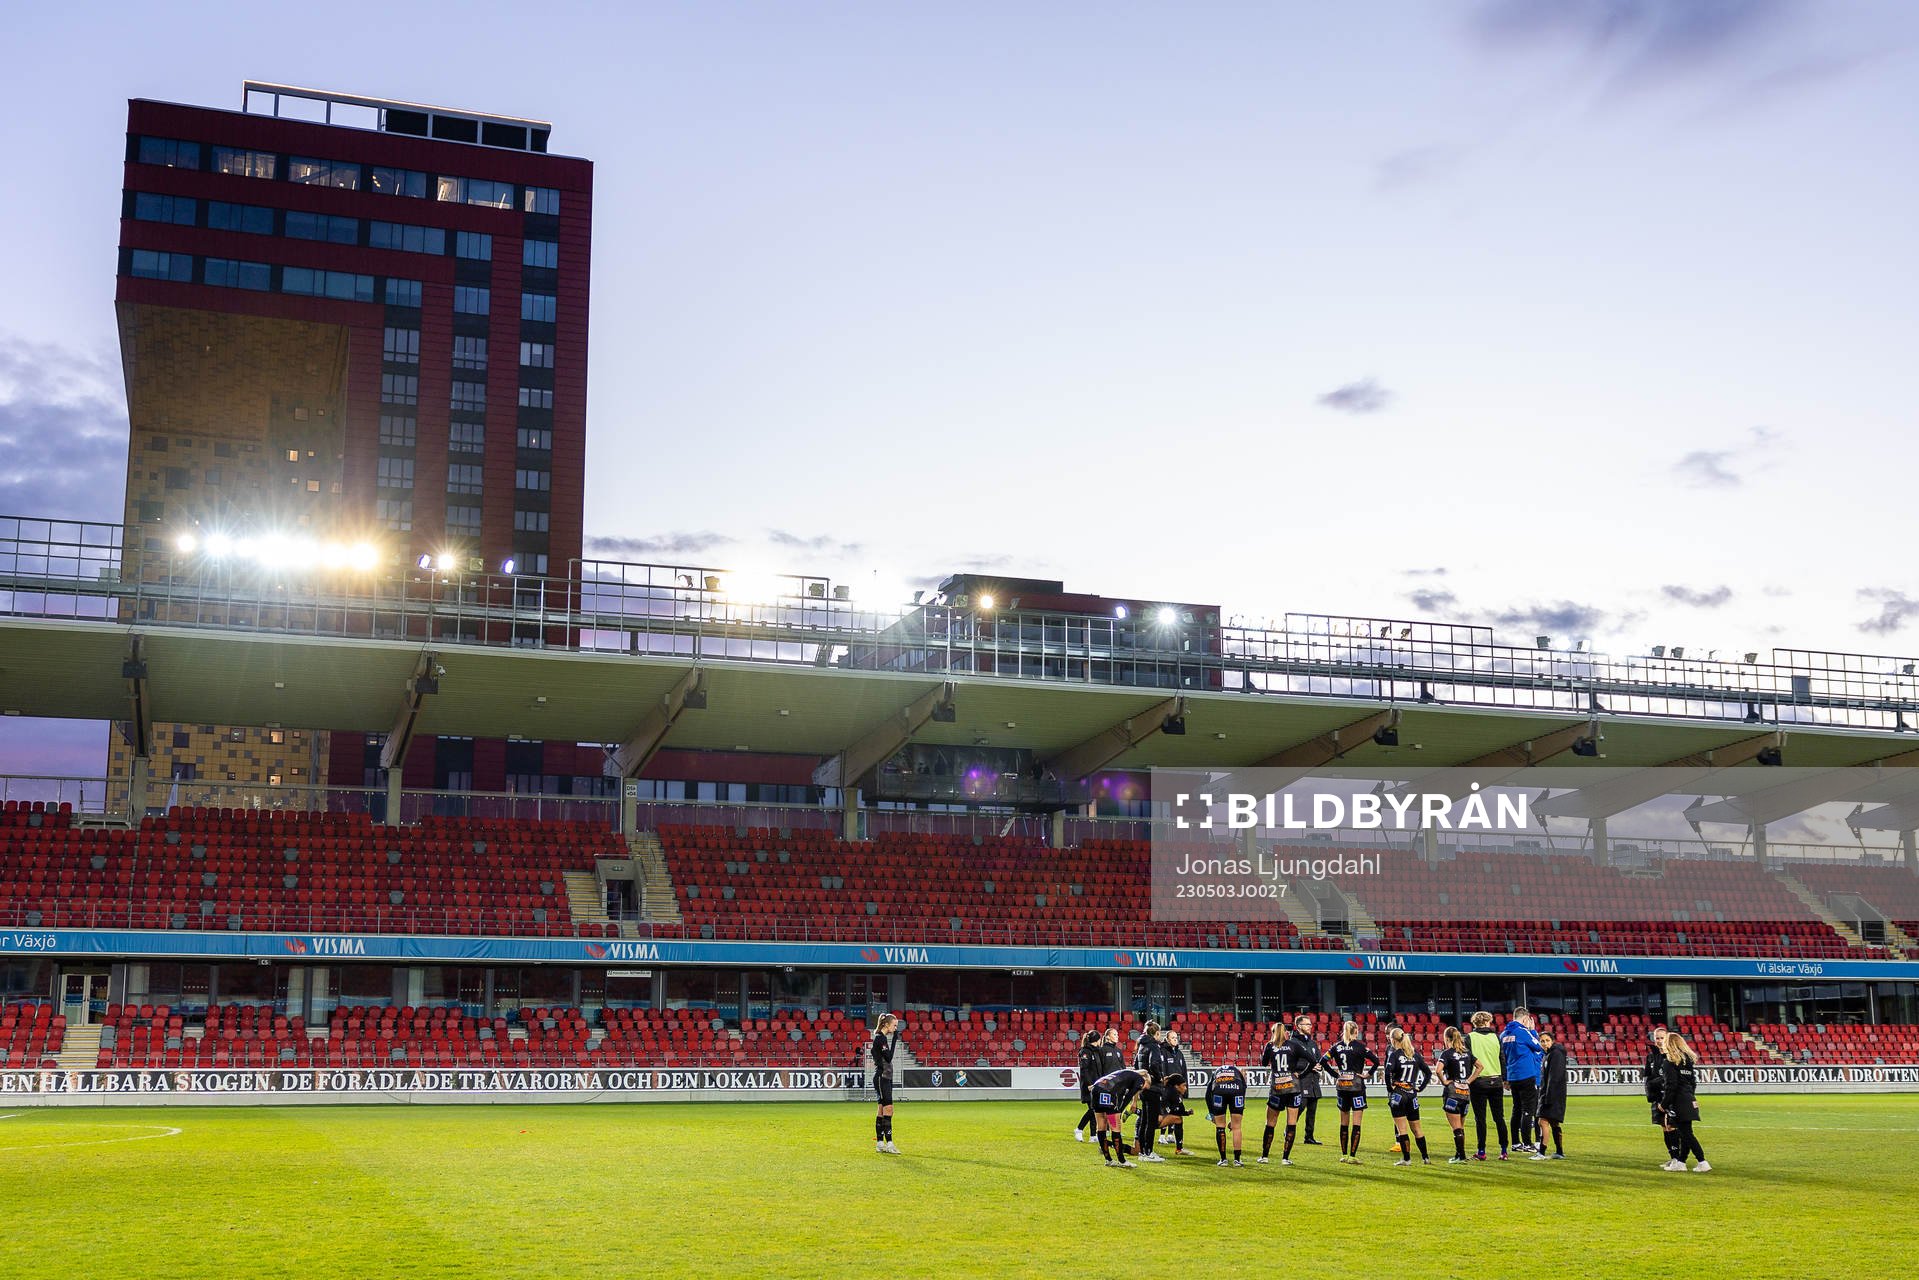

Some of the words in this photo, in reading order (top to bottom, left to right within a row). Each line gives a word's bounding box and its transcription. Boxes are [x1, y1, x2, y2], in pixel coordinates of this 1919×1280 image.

[0, 936, 9, 947] r
[14, 934, 56, 951] Växjö
[312, 938, 366, 954] VISMA
[610, 943, 660, 959] VISMA
[883, 947, 929, 963] VISMA
[1135, 951, 1178, 967] VISMA
[1367, 955, 1407, 970] VISMA
[1582, 959, 1619, 973] VISMA
[1756, 963, 1766, 973] Vi
[1768, 963, 1796, 974] älskar
[1797, 964, 1823, 976] Växjö
[1275, 1053, 1289, 1072] 14
[1339, 1053, 1348, 1071] 3
[1459, 1060, 1467, 1079] 5
[176, 1073, 276, 1092] SKOGEN,
[282, 1073, 312, 1091] DE
[318, 1070, 453, 1091] FÖRÄDLADE
[458, 1070, 604, 1090] TRÄVARORNA
[607, 1072, 652, 1090] OCH
[656, 1072, 700, 1090] DEN
[703, 1072, 784, 1090] LOKALA
[1400, 1064, 1414, 1082] 77
[1567, 1069, 1618, 1084] DLADE
[1724, 1068, 1755, 1083] OCH
[1757, 1068, 1787, 1083] DEN
[1789, 1068, 1846, 1083] LOKALA
[1849, 1068, 1919, 1083] IDROTTEN
